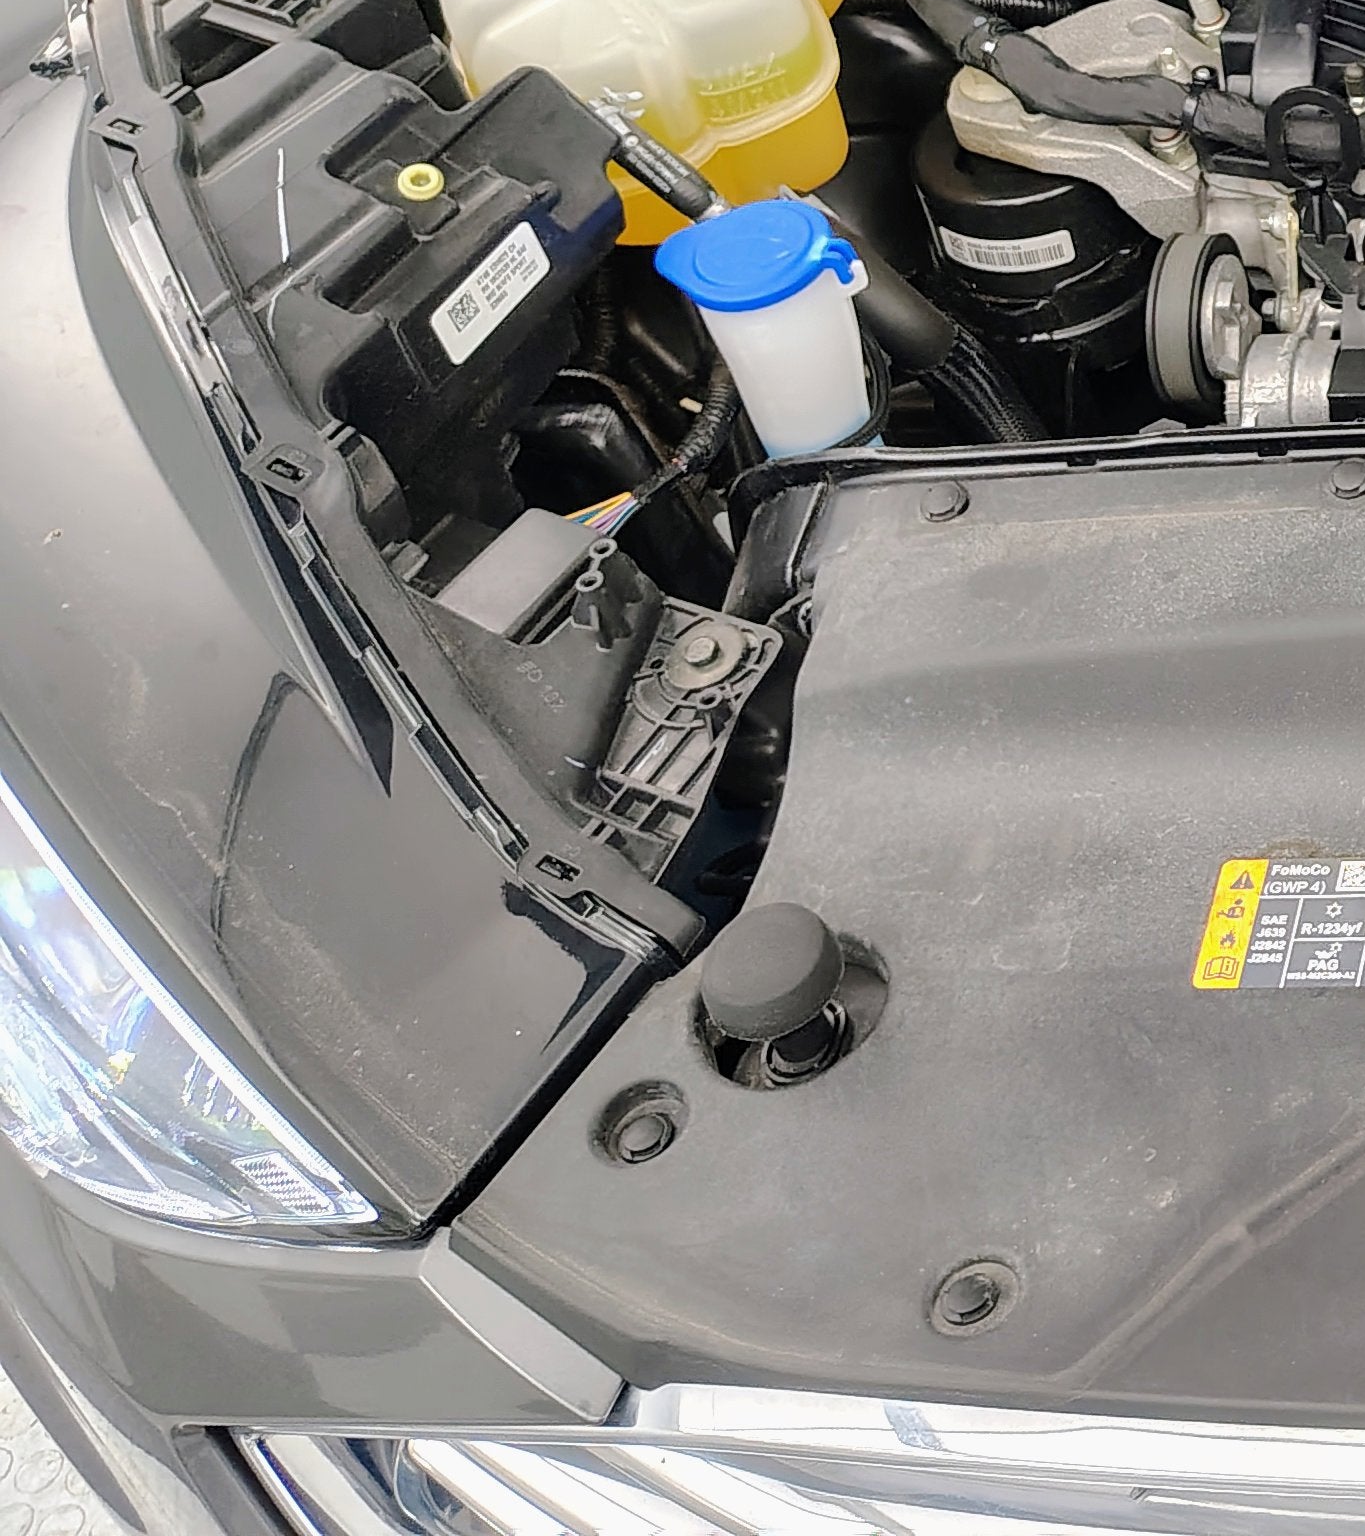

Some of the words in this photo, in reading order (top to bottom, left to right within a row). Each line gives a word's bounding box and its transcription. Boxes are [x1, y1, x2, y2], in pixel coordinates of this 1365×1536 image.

[1271, 864, 1331, 876] FoMoCo
[1263, 881, 1309, 895] (GWP
[1309, 881, 1327, 895] 4)
[1260, 915, 1289, 925] SAE
[1255, 927, 1287, 938] J639
[1300, 922, 1364, 936] R-1234yf
[1307, 959, 1339, 971] PAG
